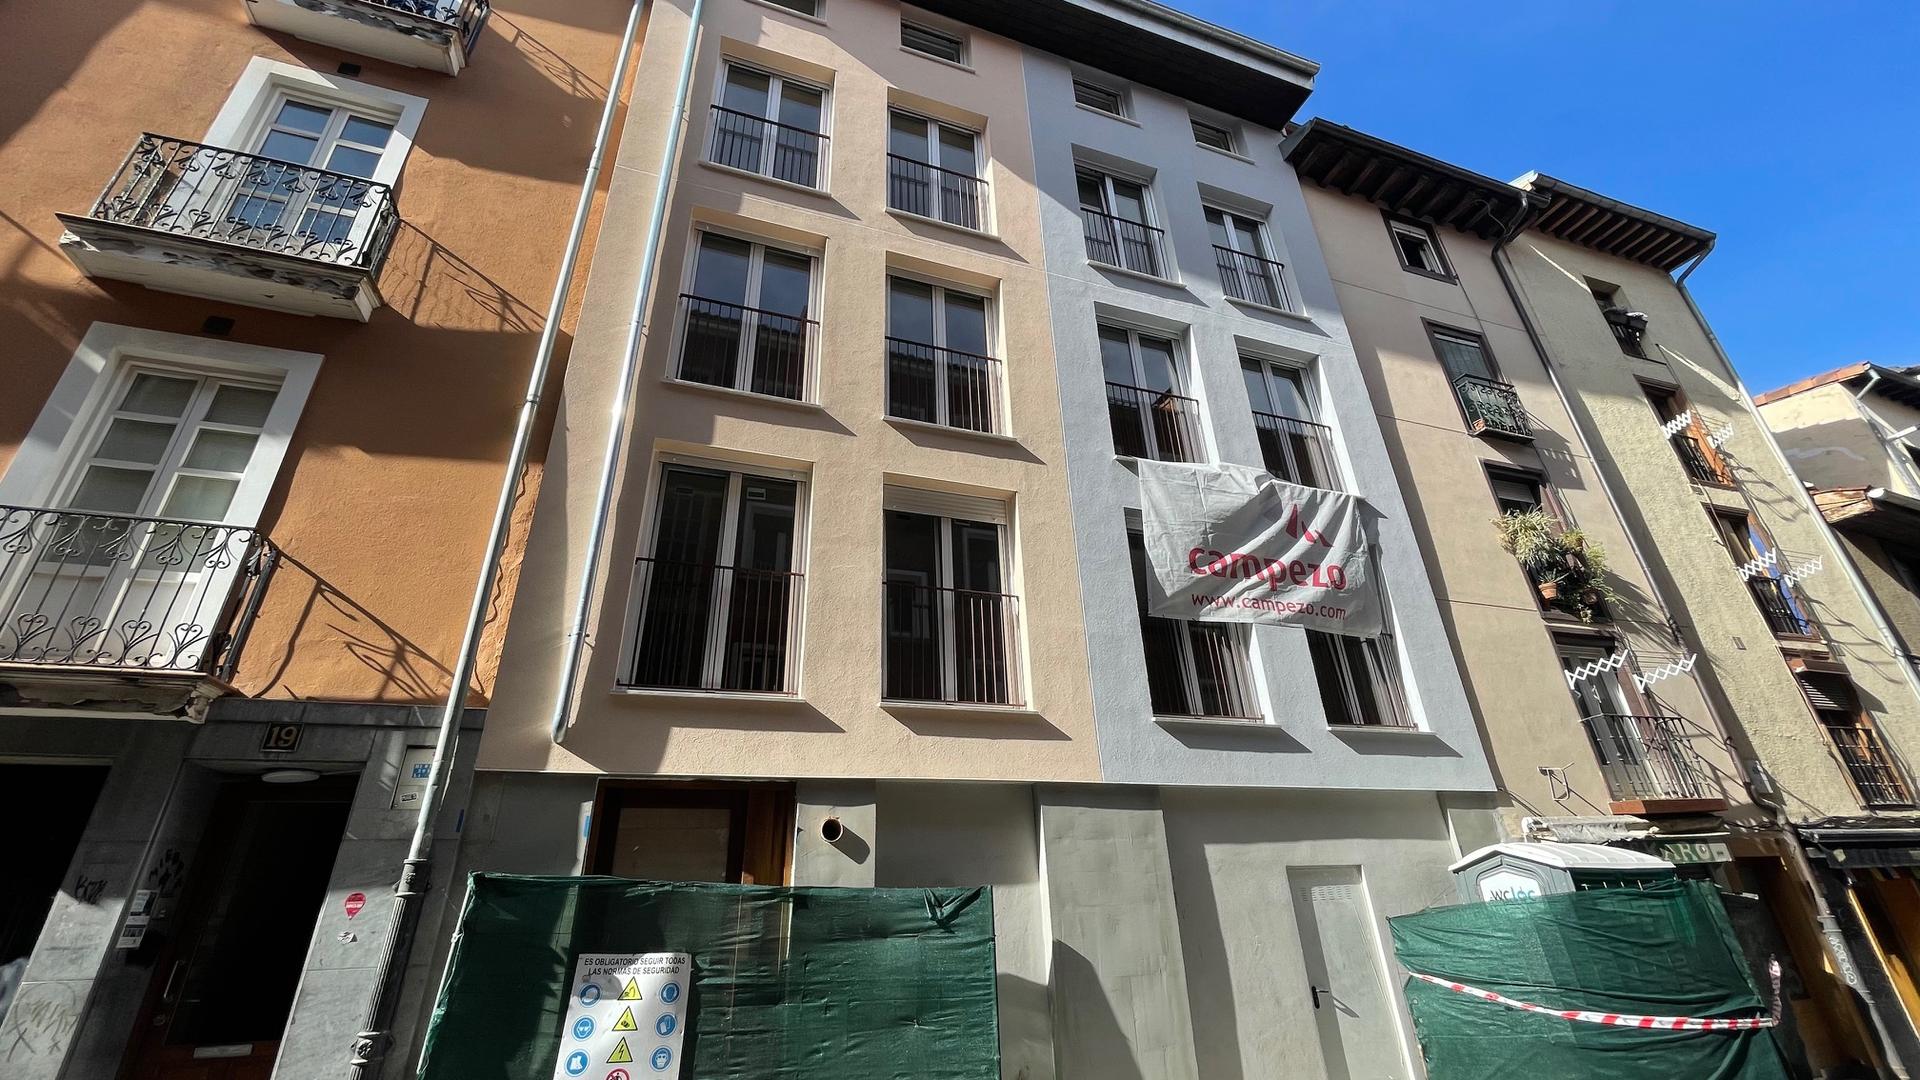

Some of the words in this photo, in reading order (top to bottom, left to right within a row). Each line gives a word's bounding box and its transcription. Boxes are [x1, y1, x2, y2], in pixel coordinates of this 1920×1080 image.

[1188, 547, 1348, 592] campezo
[1191, 593, 1346, 621] www.campezo.com
[265, 726, 297, 747] 19
[584, 957, 594, 966] ES
[594, 957, 639, 967] OBLIGATORIO
[639, 957, 664, 966] SEGUIR
[665, 956, 686, 965] TODAS
[588, 967, 602, 976] LAS
[602, 967, 632, 976] NORMAS
[632, 967, 642, 975] DE
[642, 966, 680, 975] SEGURIDAD
